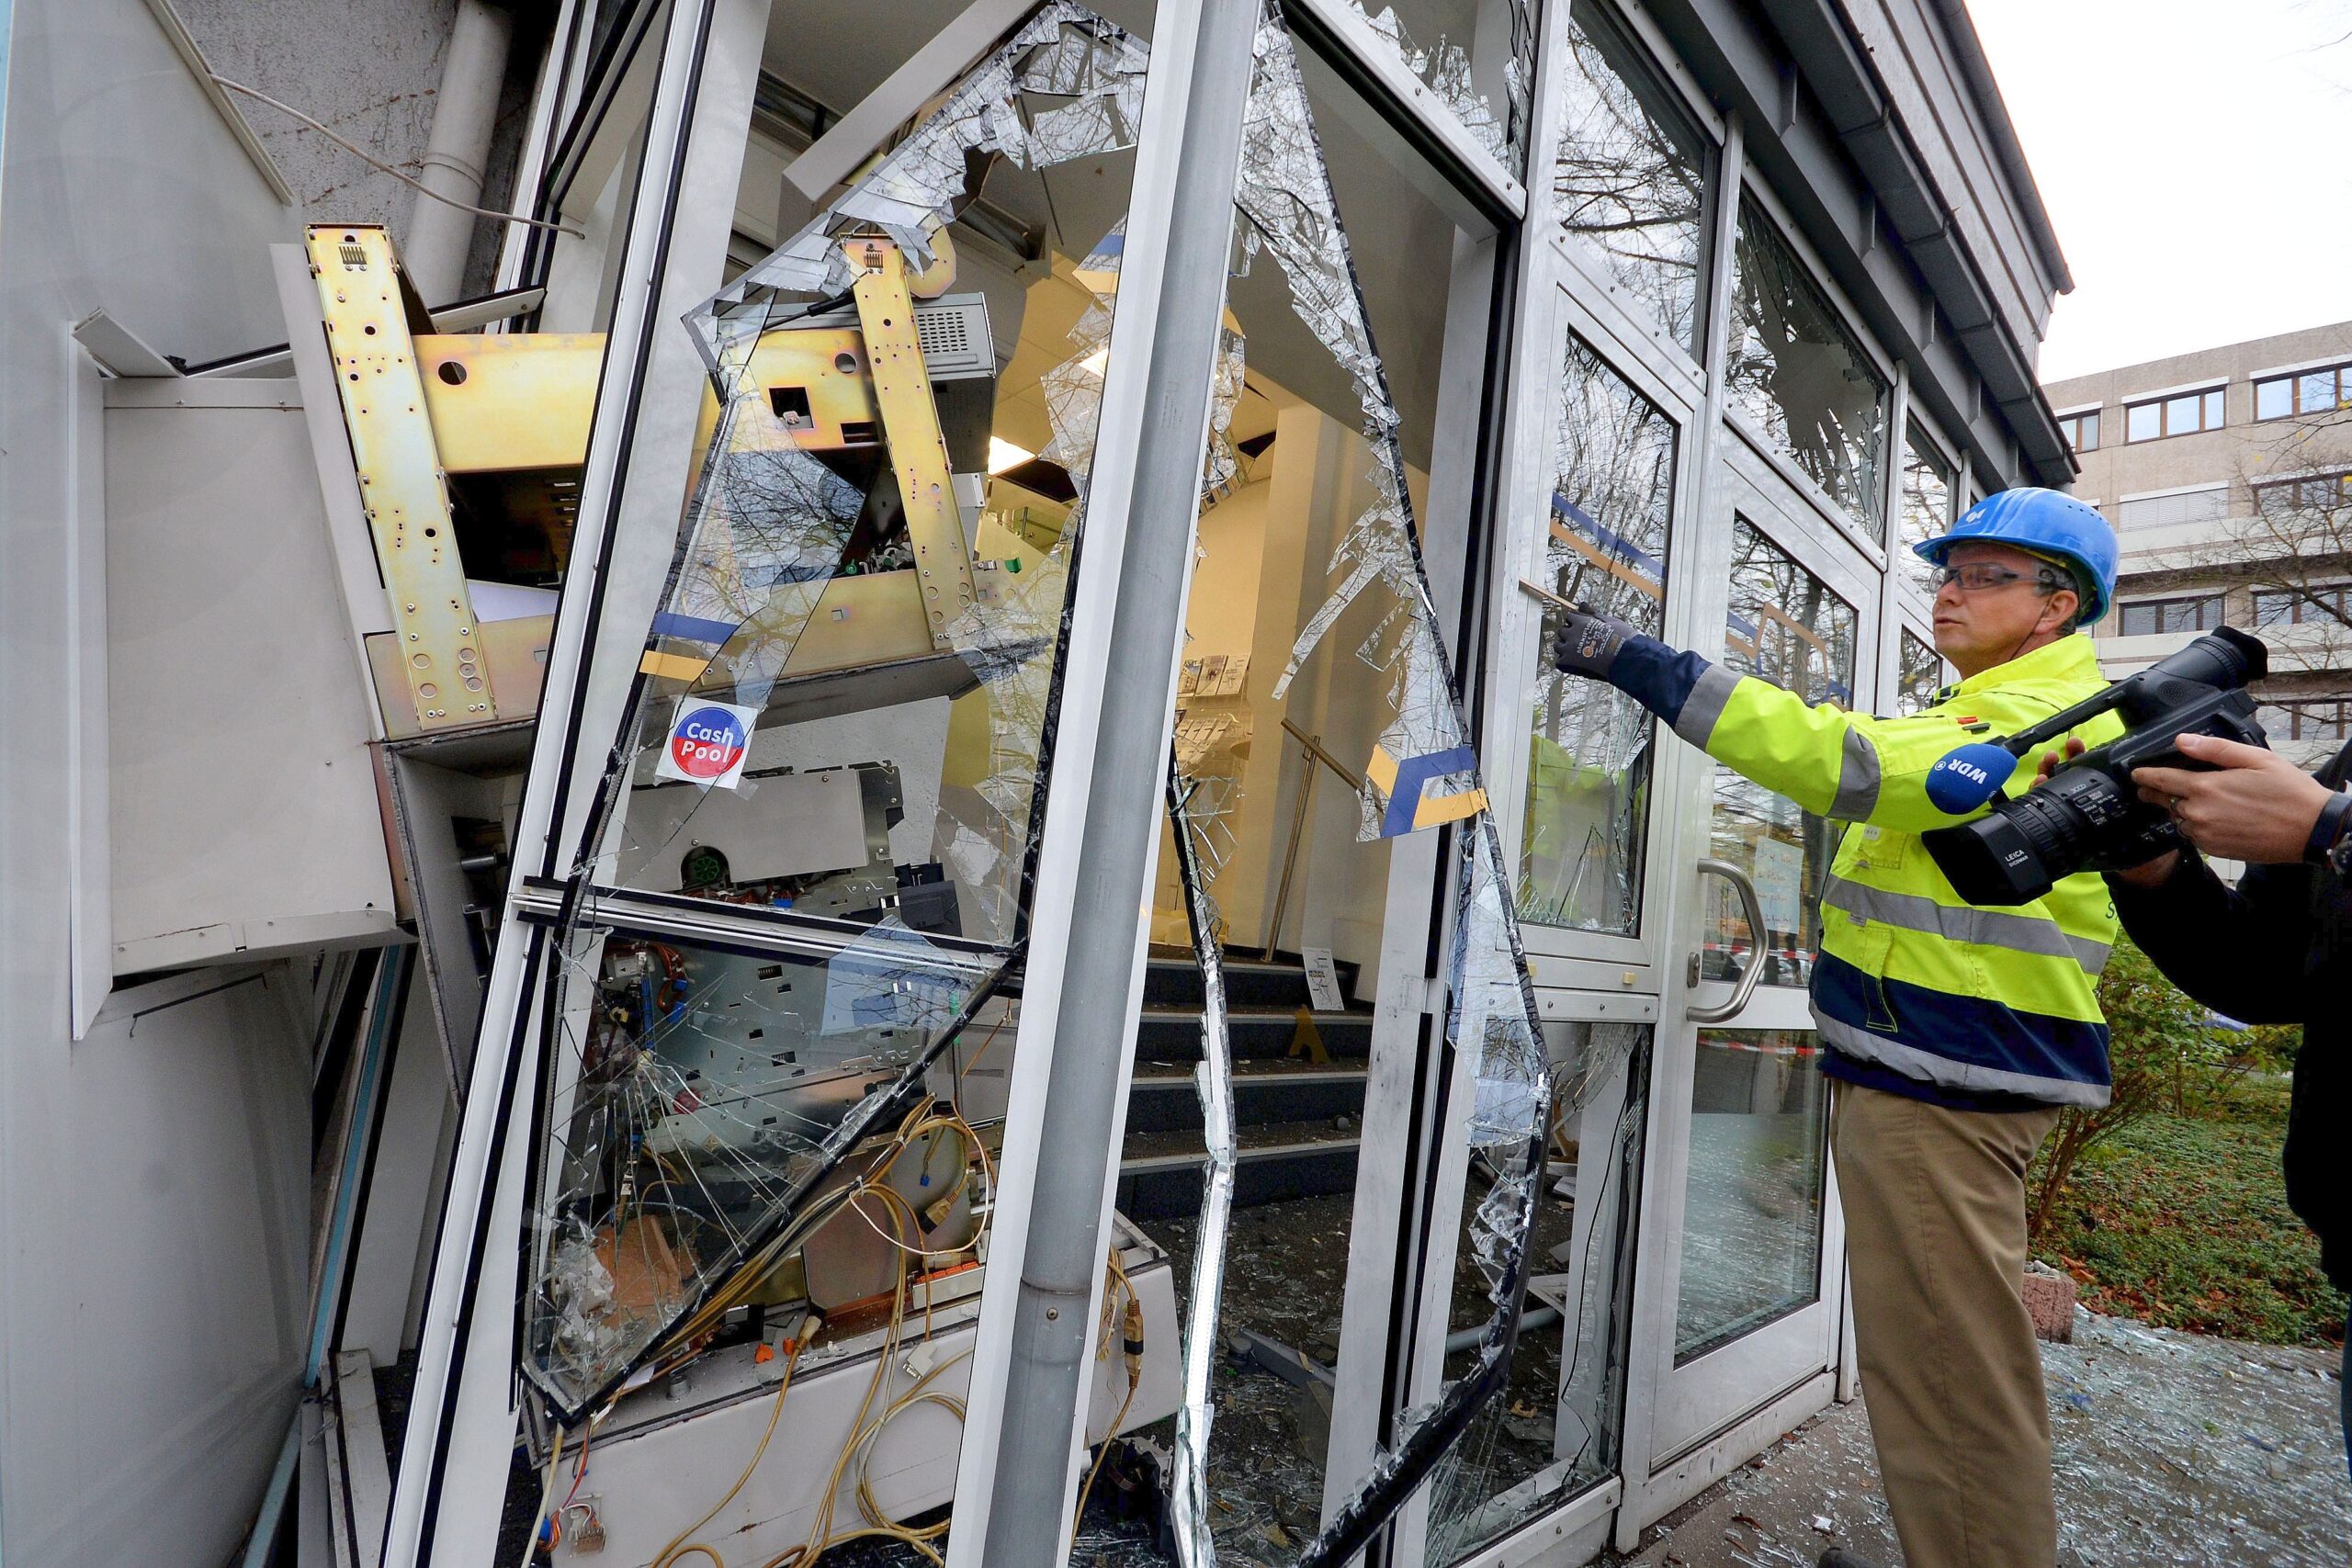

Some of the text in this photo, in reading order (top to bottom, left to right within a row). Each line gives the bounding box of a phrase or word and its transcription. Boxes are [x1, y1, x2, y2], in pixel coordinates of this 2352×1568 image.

[686, 723, 734, 746] Cash
[681, 735, 734, 763] Pool
[1948, 758, 1987, 784] WDR
[2005, 850, 2025, 862] LEICA
